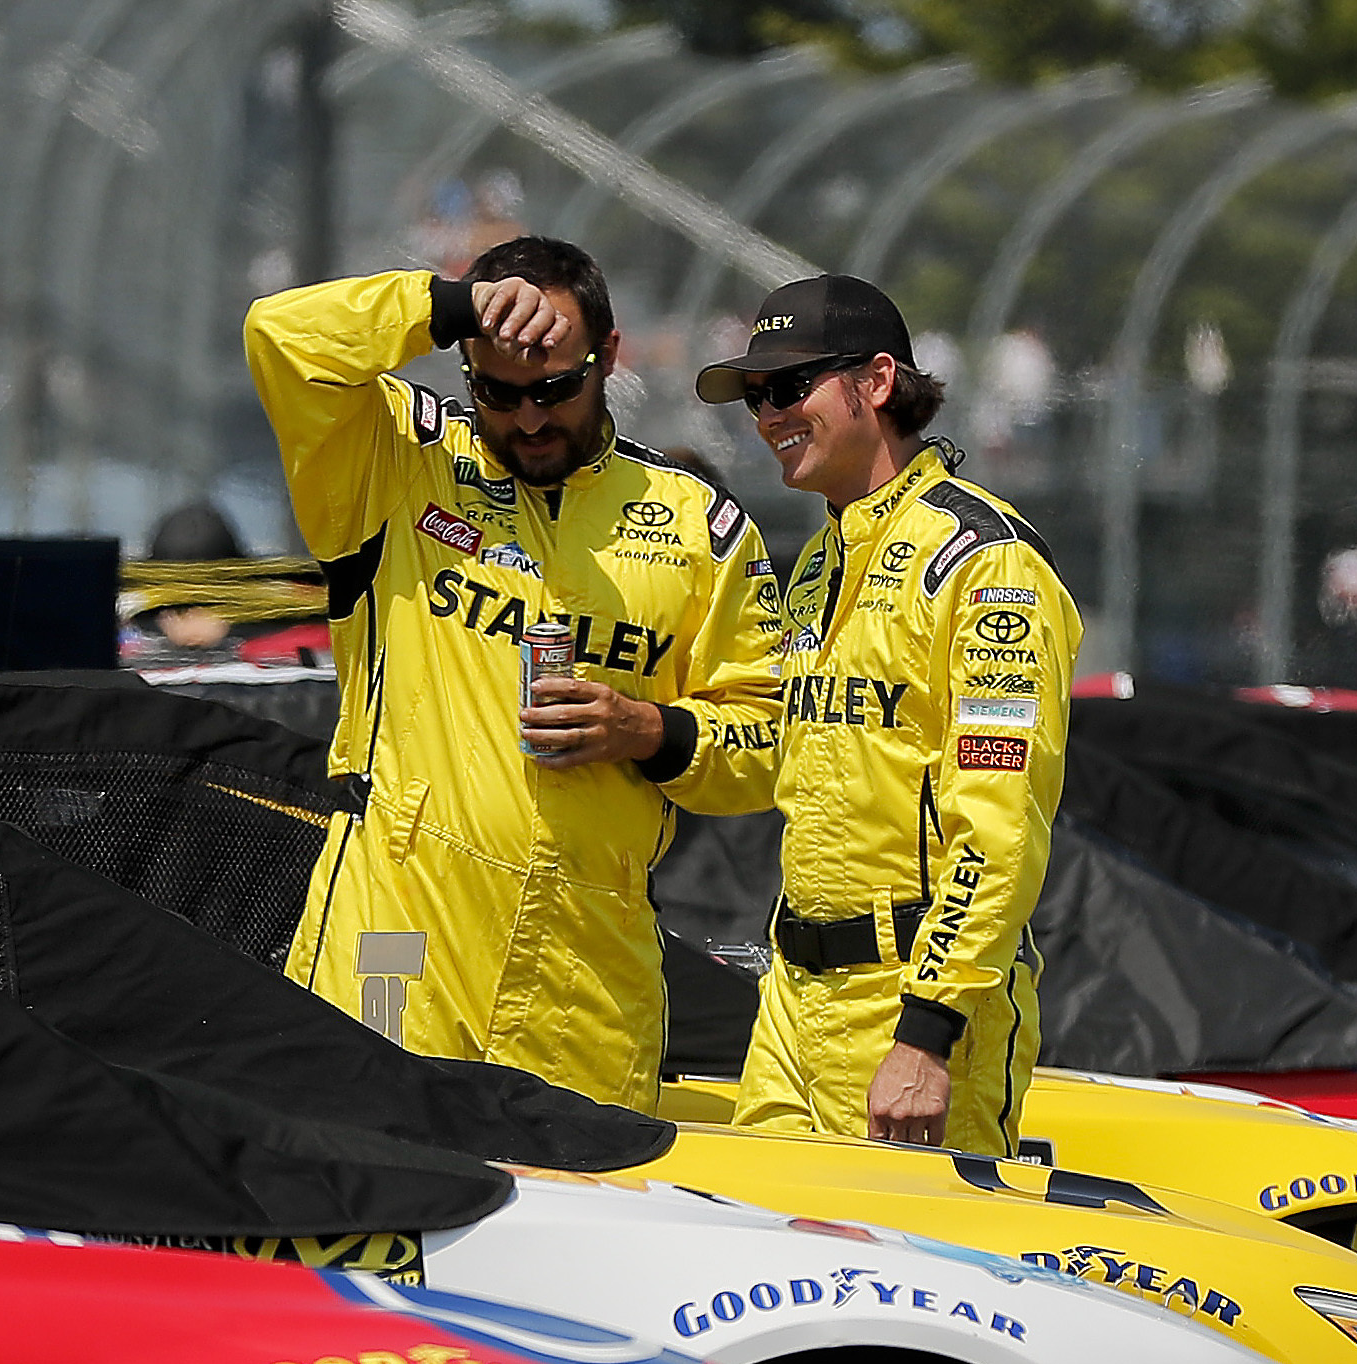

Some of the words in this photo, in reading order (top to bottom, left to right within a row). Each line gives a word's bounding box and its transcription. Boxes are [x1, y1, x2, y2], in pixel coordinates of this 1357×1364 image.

[616, 525, 683, 546] TOYOTA
[480, 547, 542, 578] PEAK
[985, 588, 1035, 605] NASCAR
[538, 649, 569, 664] NOS
[966, 647, 1037, 665] TOYOTA
[967, 704, 1027, 719] SIEMENS
[959, 752, 1024, 769] DECKER
[917, 842, 987, 981] STANLEY
[1020, 1246, 1242, 1327] DYEAR
[673, 1268, 1027, 1343] GOODYEAR
